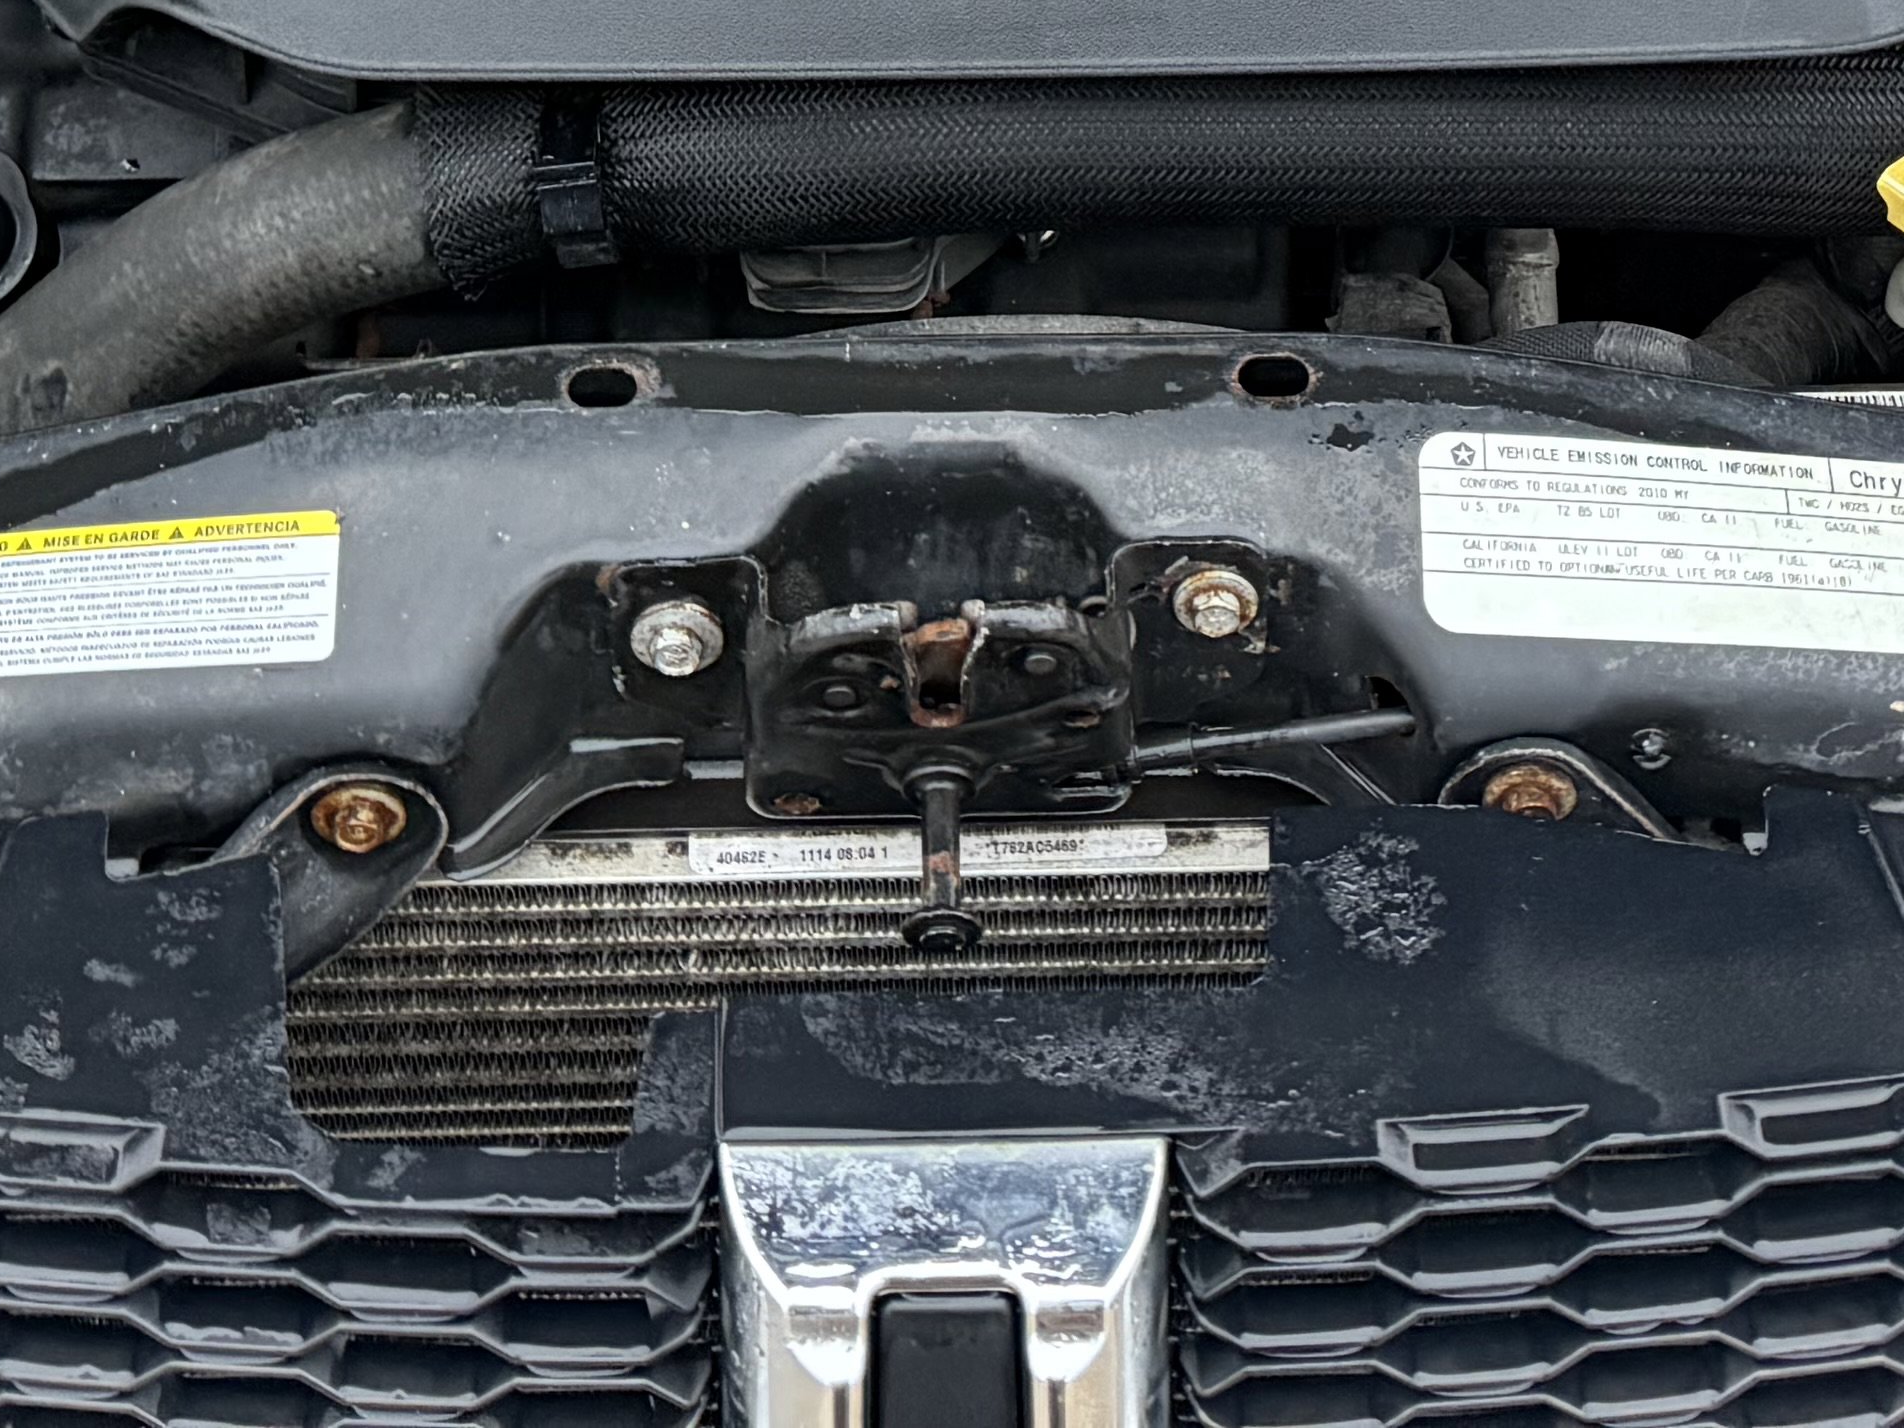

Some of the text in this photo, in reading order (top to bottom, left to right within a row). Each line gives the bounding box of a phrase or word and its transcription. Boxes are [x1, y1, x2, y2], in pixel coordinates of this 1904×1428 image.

[1497, 446, 1814, 479] VEHICLE EMISSION CONTROL INFORMATION
[1459, 477, 1519, 490] CONFORMS
[1527, 480, 1540, 492] TO
[1547, 482, 1628, 496] REGULATIONS
[1638, 487, 1667, 498] 2010
[43, 534, 80, 548] MISE
[84, 533, 104, 545] EN
[109, 529, 160, 544] GARDE
[194, 520, 301, 537] ADVERTENCIA
[1462, 539, 1537, 552] CALIFORNIA
[1463, 557, 1530, 571] CERTIFIED
[1538, 560, 1552, 572] TO
[1677, 568, 1706, 580] LIFE
[800, 848, 832, 861] 1114
